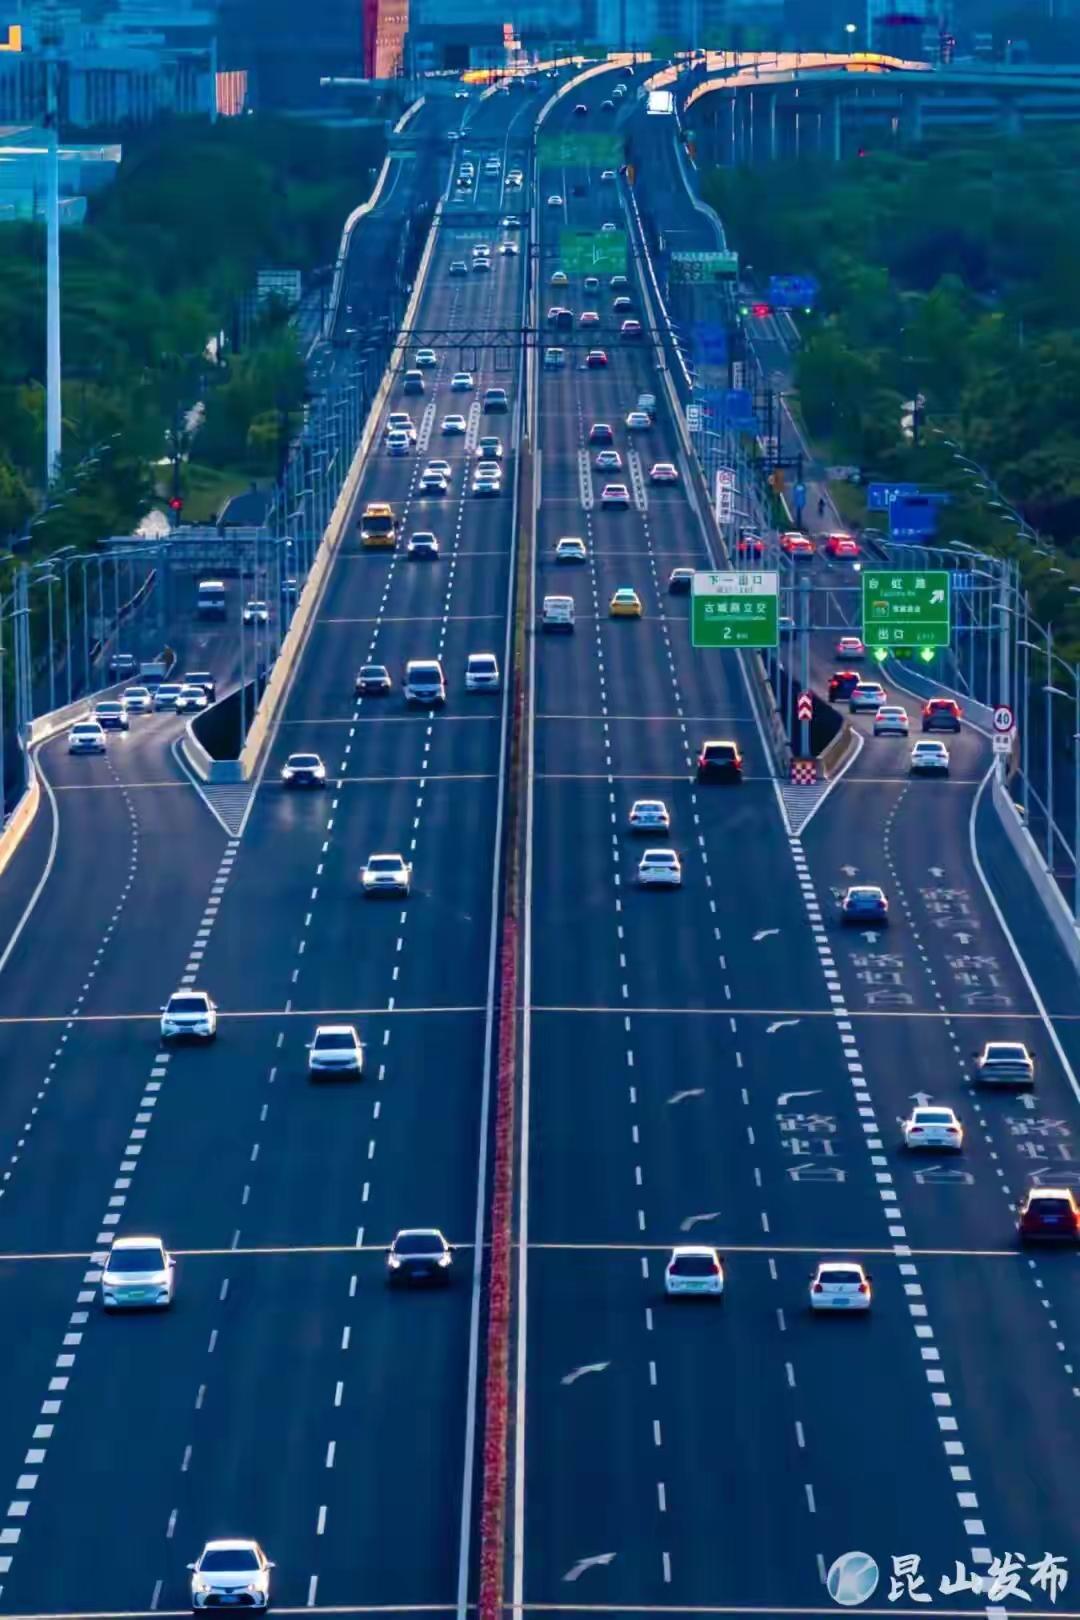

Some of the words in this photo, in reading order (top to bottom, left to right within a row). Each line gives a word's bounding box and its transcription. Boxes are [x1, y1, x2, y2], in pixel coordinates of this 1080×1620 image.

[708, 575, 762, 586] 下一出口
[723, 626, 732, 640] 2
[878, 628, 904, 640] 出口
[997, 713, 1010, 725] 40
